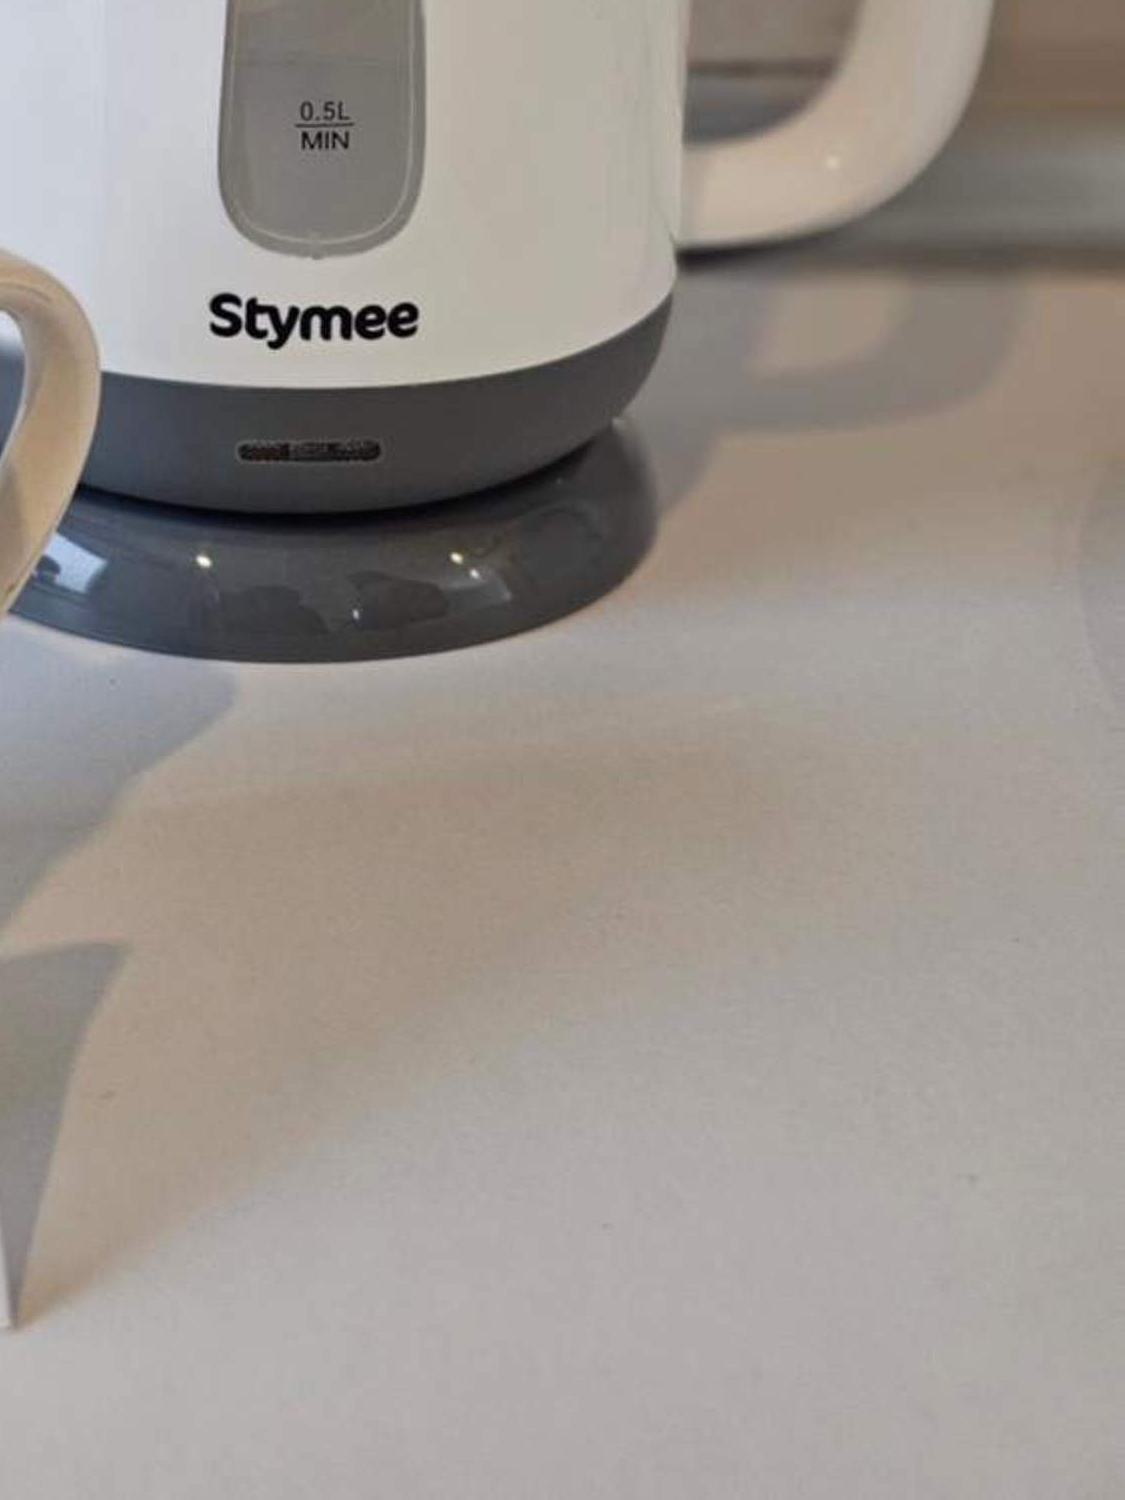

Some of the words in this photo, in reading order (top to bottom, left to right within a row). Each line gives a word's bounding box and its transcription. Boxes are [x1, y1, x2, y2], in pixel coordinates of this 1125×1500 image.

[299, 101, 351, 121] 0.5L
[300, 131, 350, 150] MIN
[209, 293, 419, 350] Stymee
